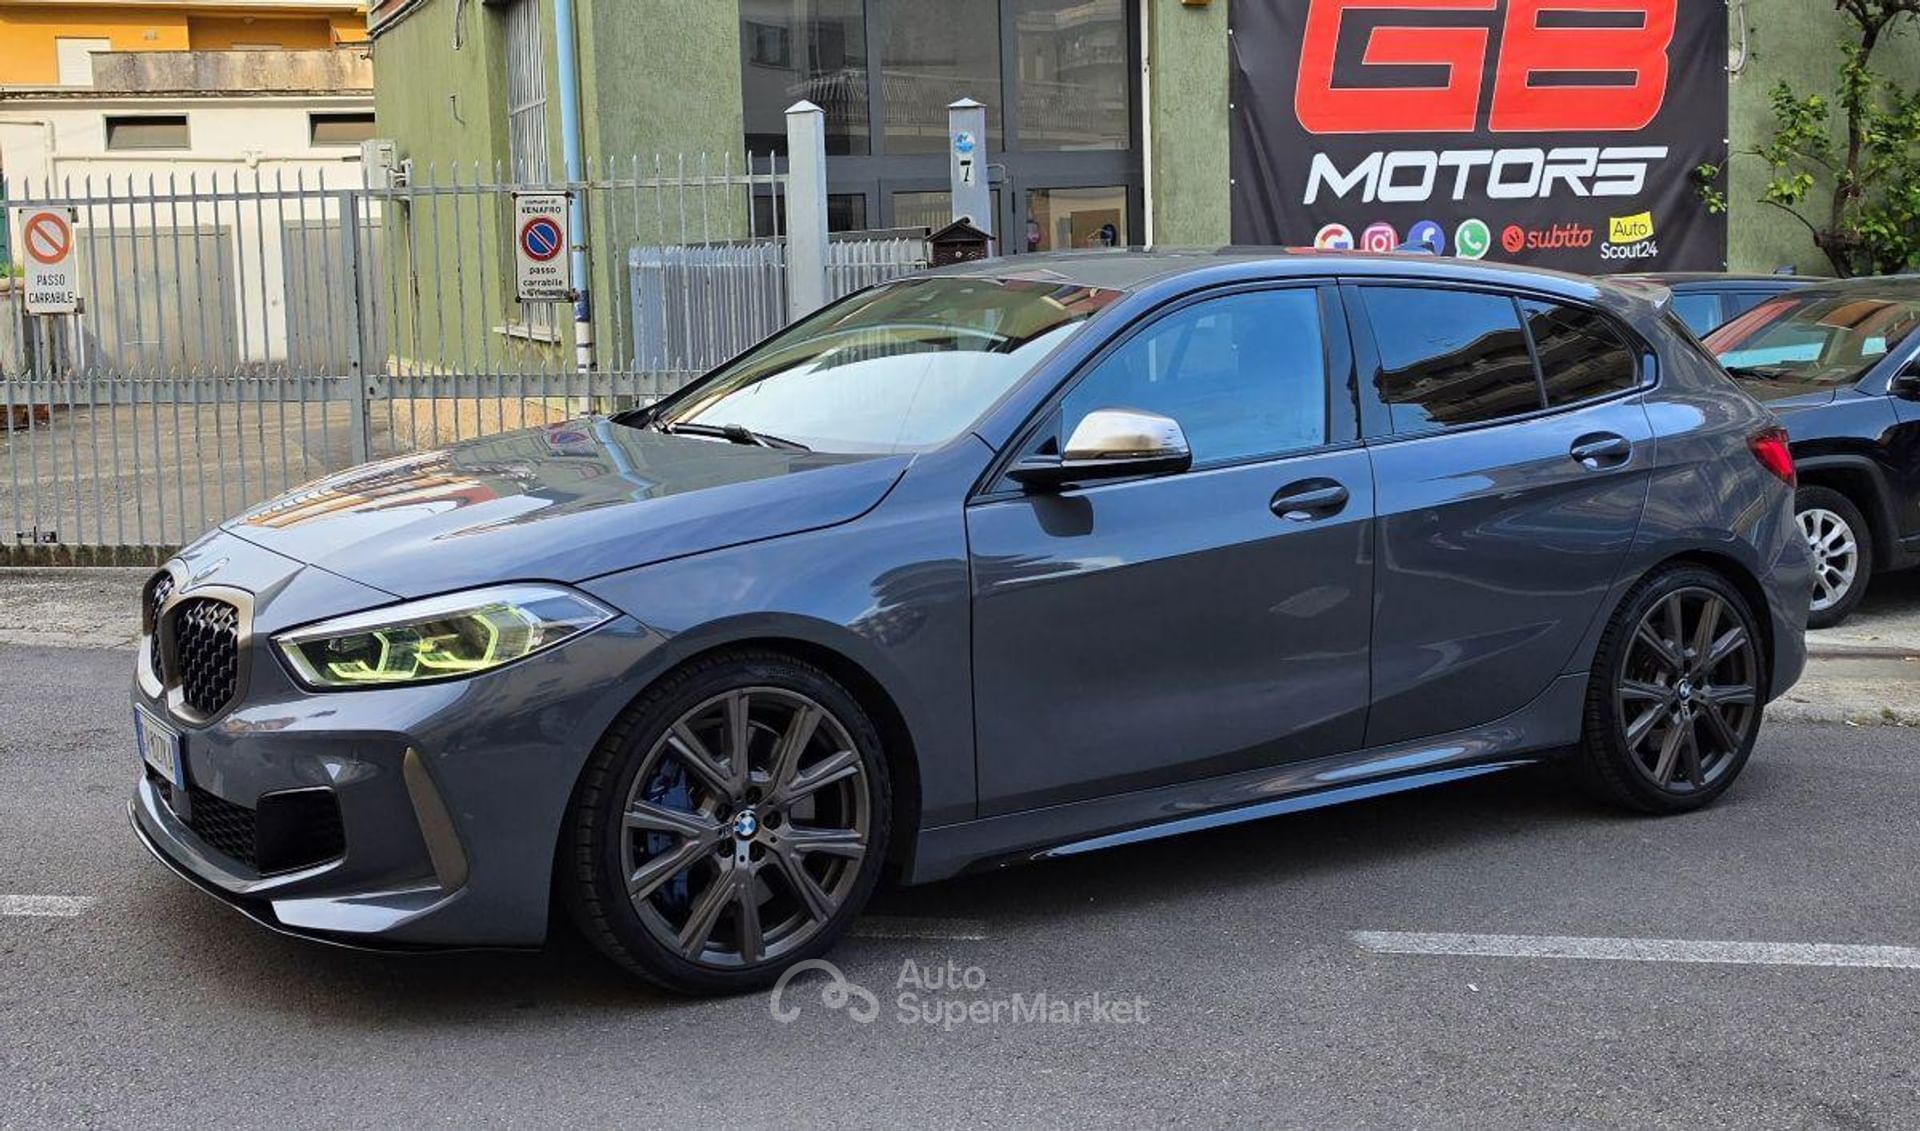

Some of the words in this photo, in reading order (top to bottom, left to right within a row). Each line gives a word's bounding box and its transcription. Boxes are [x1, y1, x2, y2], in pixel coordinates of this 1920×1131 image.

[1294, 0, 1677, 134] GB
[1303, 147, 1668, 204] MOTORS
[521, 206, 561, 214] VENAFRO
[1527, 223, 1593, 249] subito
[1612, 220, 1649, 237] Auto
[1600, 240, 1659, 260] Scout24
[529, 266, 557, 275] passo
[36, 273, 65, 286] PASSO
[522, 278, 563, 287] carrabile
[28, 291, 74, 304] CARRABILE
